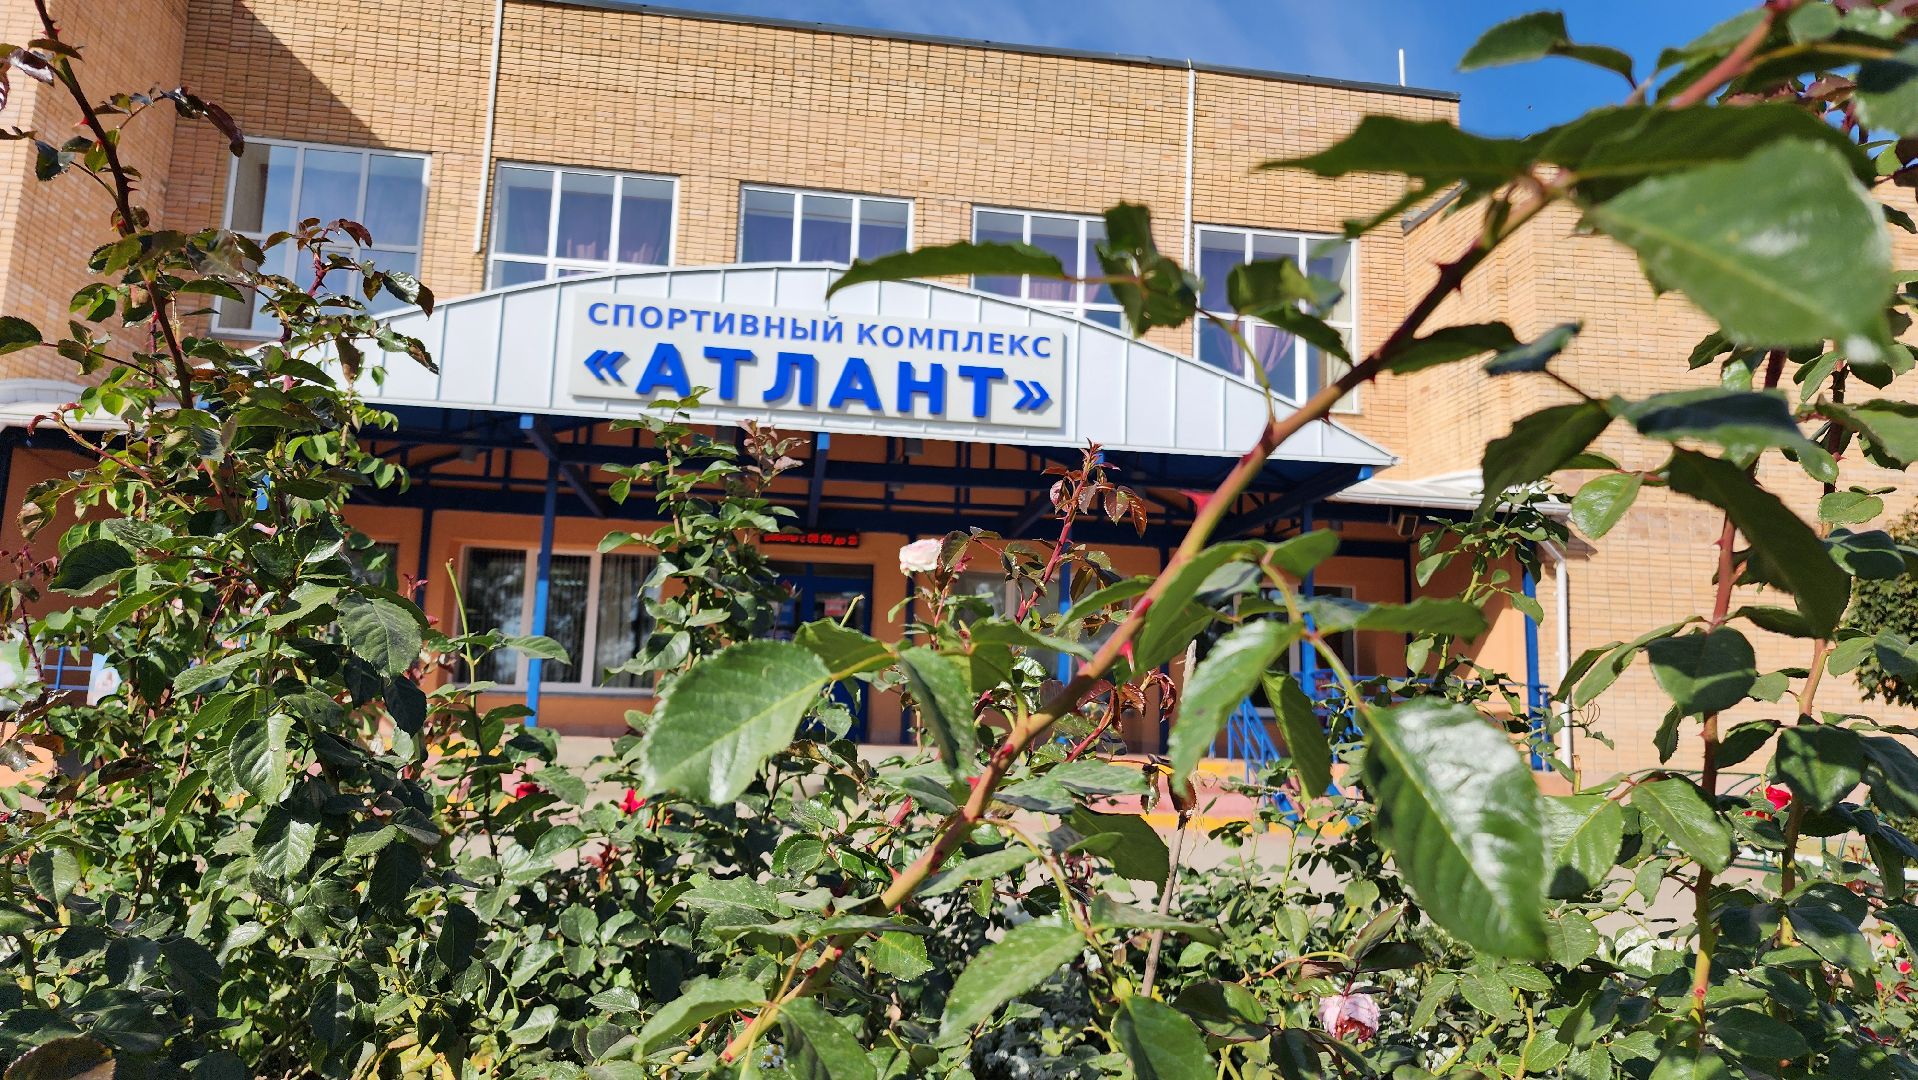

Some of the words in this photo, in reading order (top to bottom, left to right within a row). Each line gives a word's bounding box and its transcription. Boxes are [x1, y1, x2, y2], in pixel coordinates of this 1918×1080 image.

[587, 302, 844, 344] СПОРТИВНЫЙ
[856, 322, 1051, 359] КОМПЛЕКС
[583, 342, 1052, 419] «АТЛАНТ»
